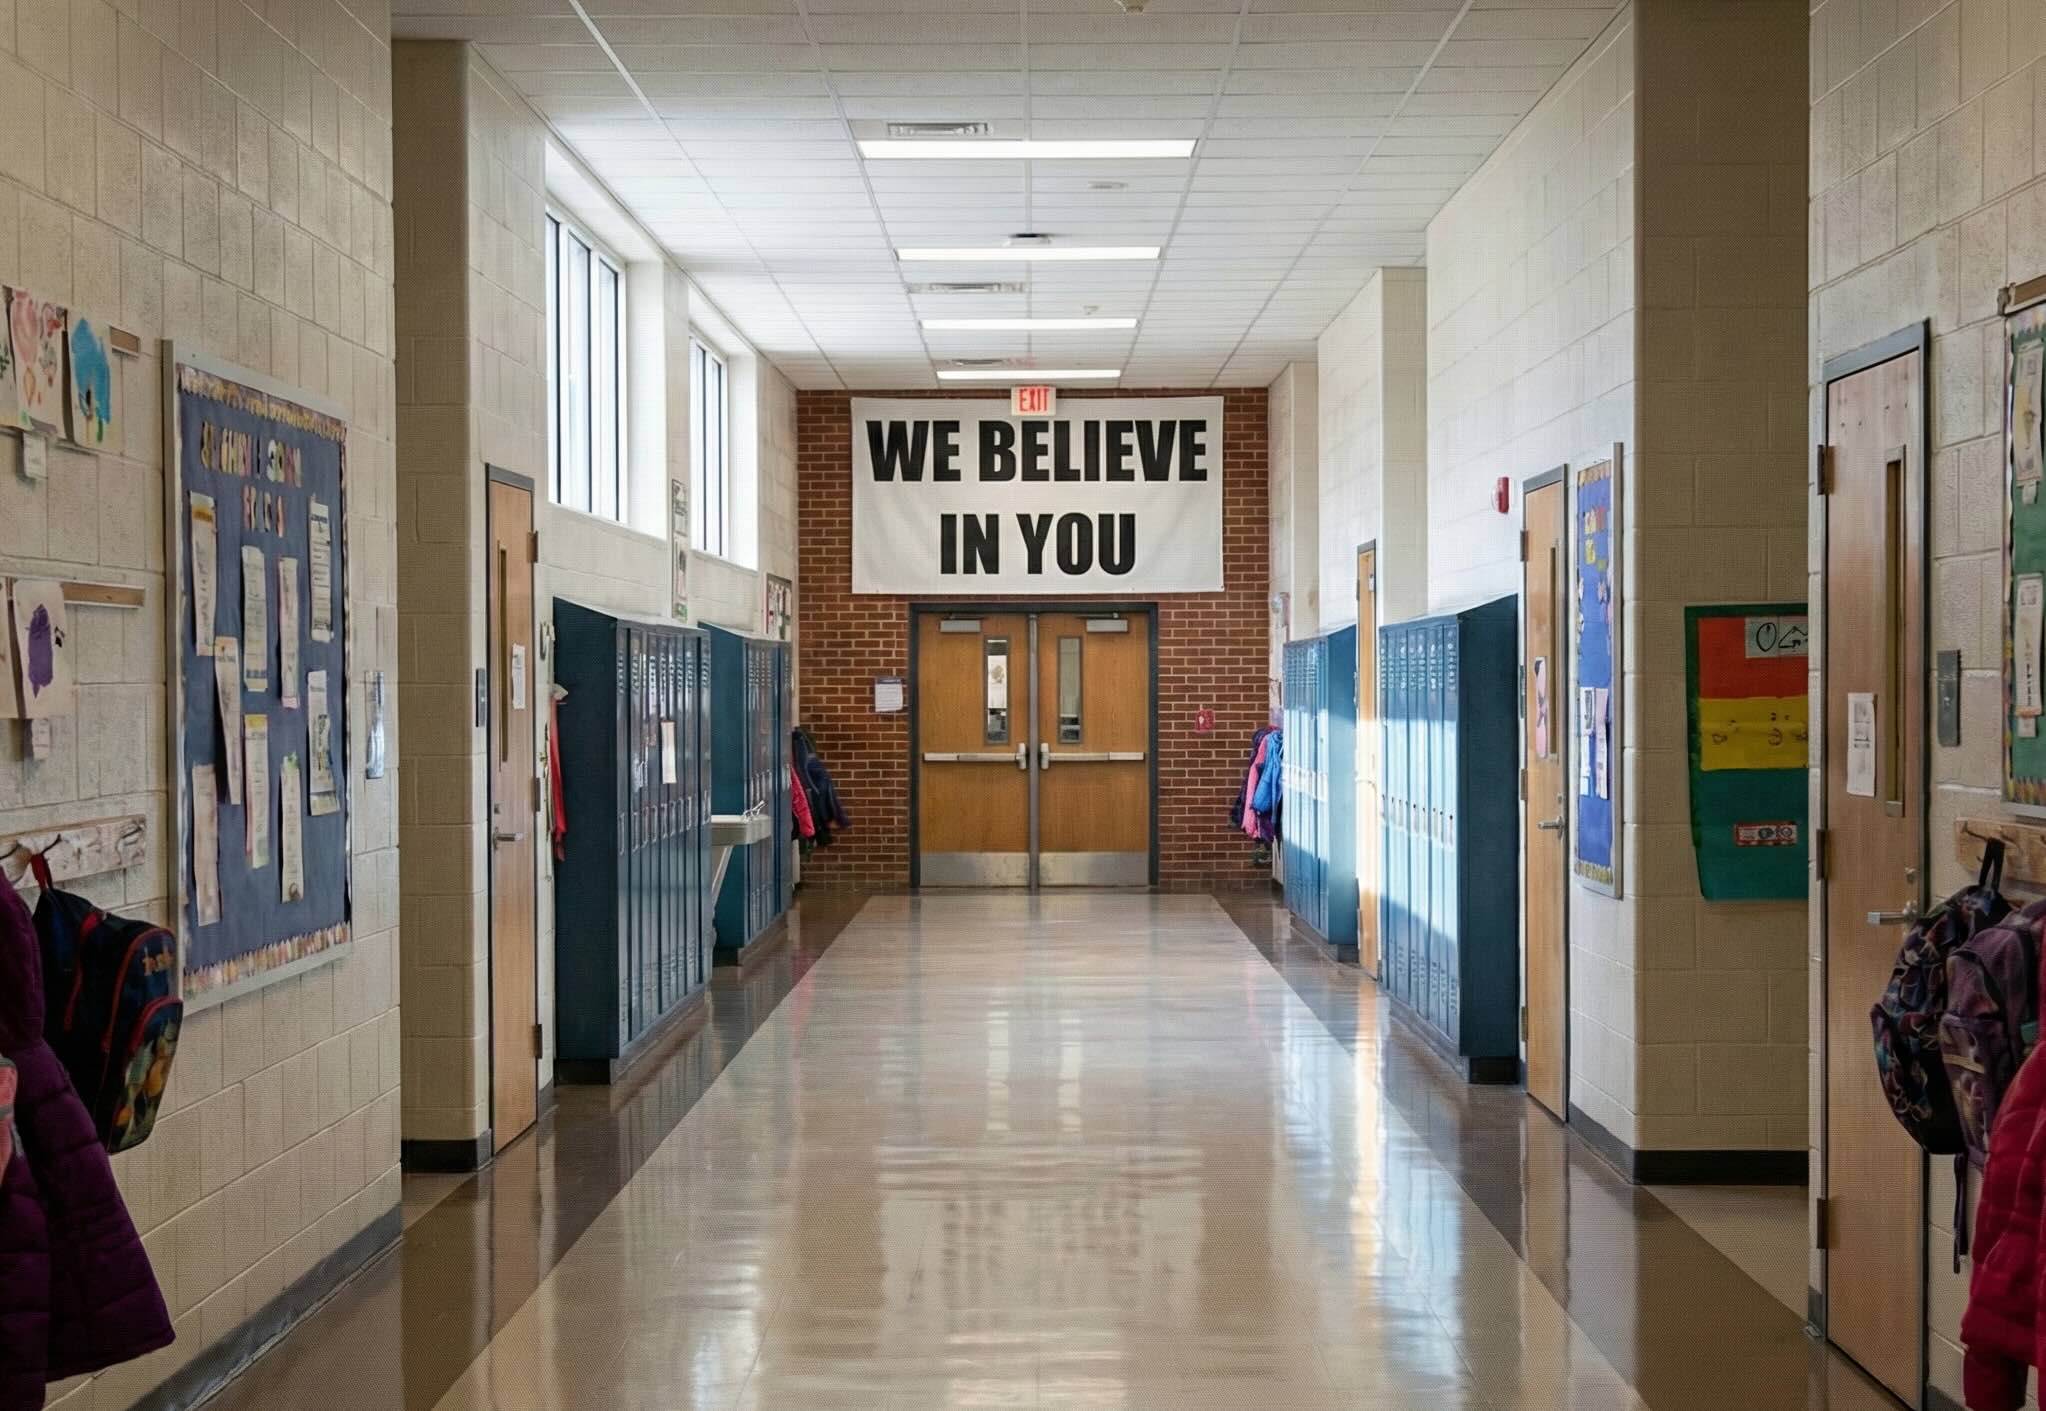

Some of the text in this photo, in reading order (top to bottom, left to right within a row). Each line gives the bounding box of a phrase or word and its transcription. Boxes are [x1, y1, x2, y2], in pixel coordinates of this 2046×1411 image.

[1020, 388, 1049, 411] EXIT
[866, 420, 1208, 481] WE BELIEVE
[940, 512, 1136, 576] IN YOU
